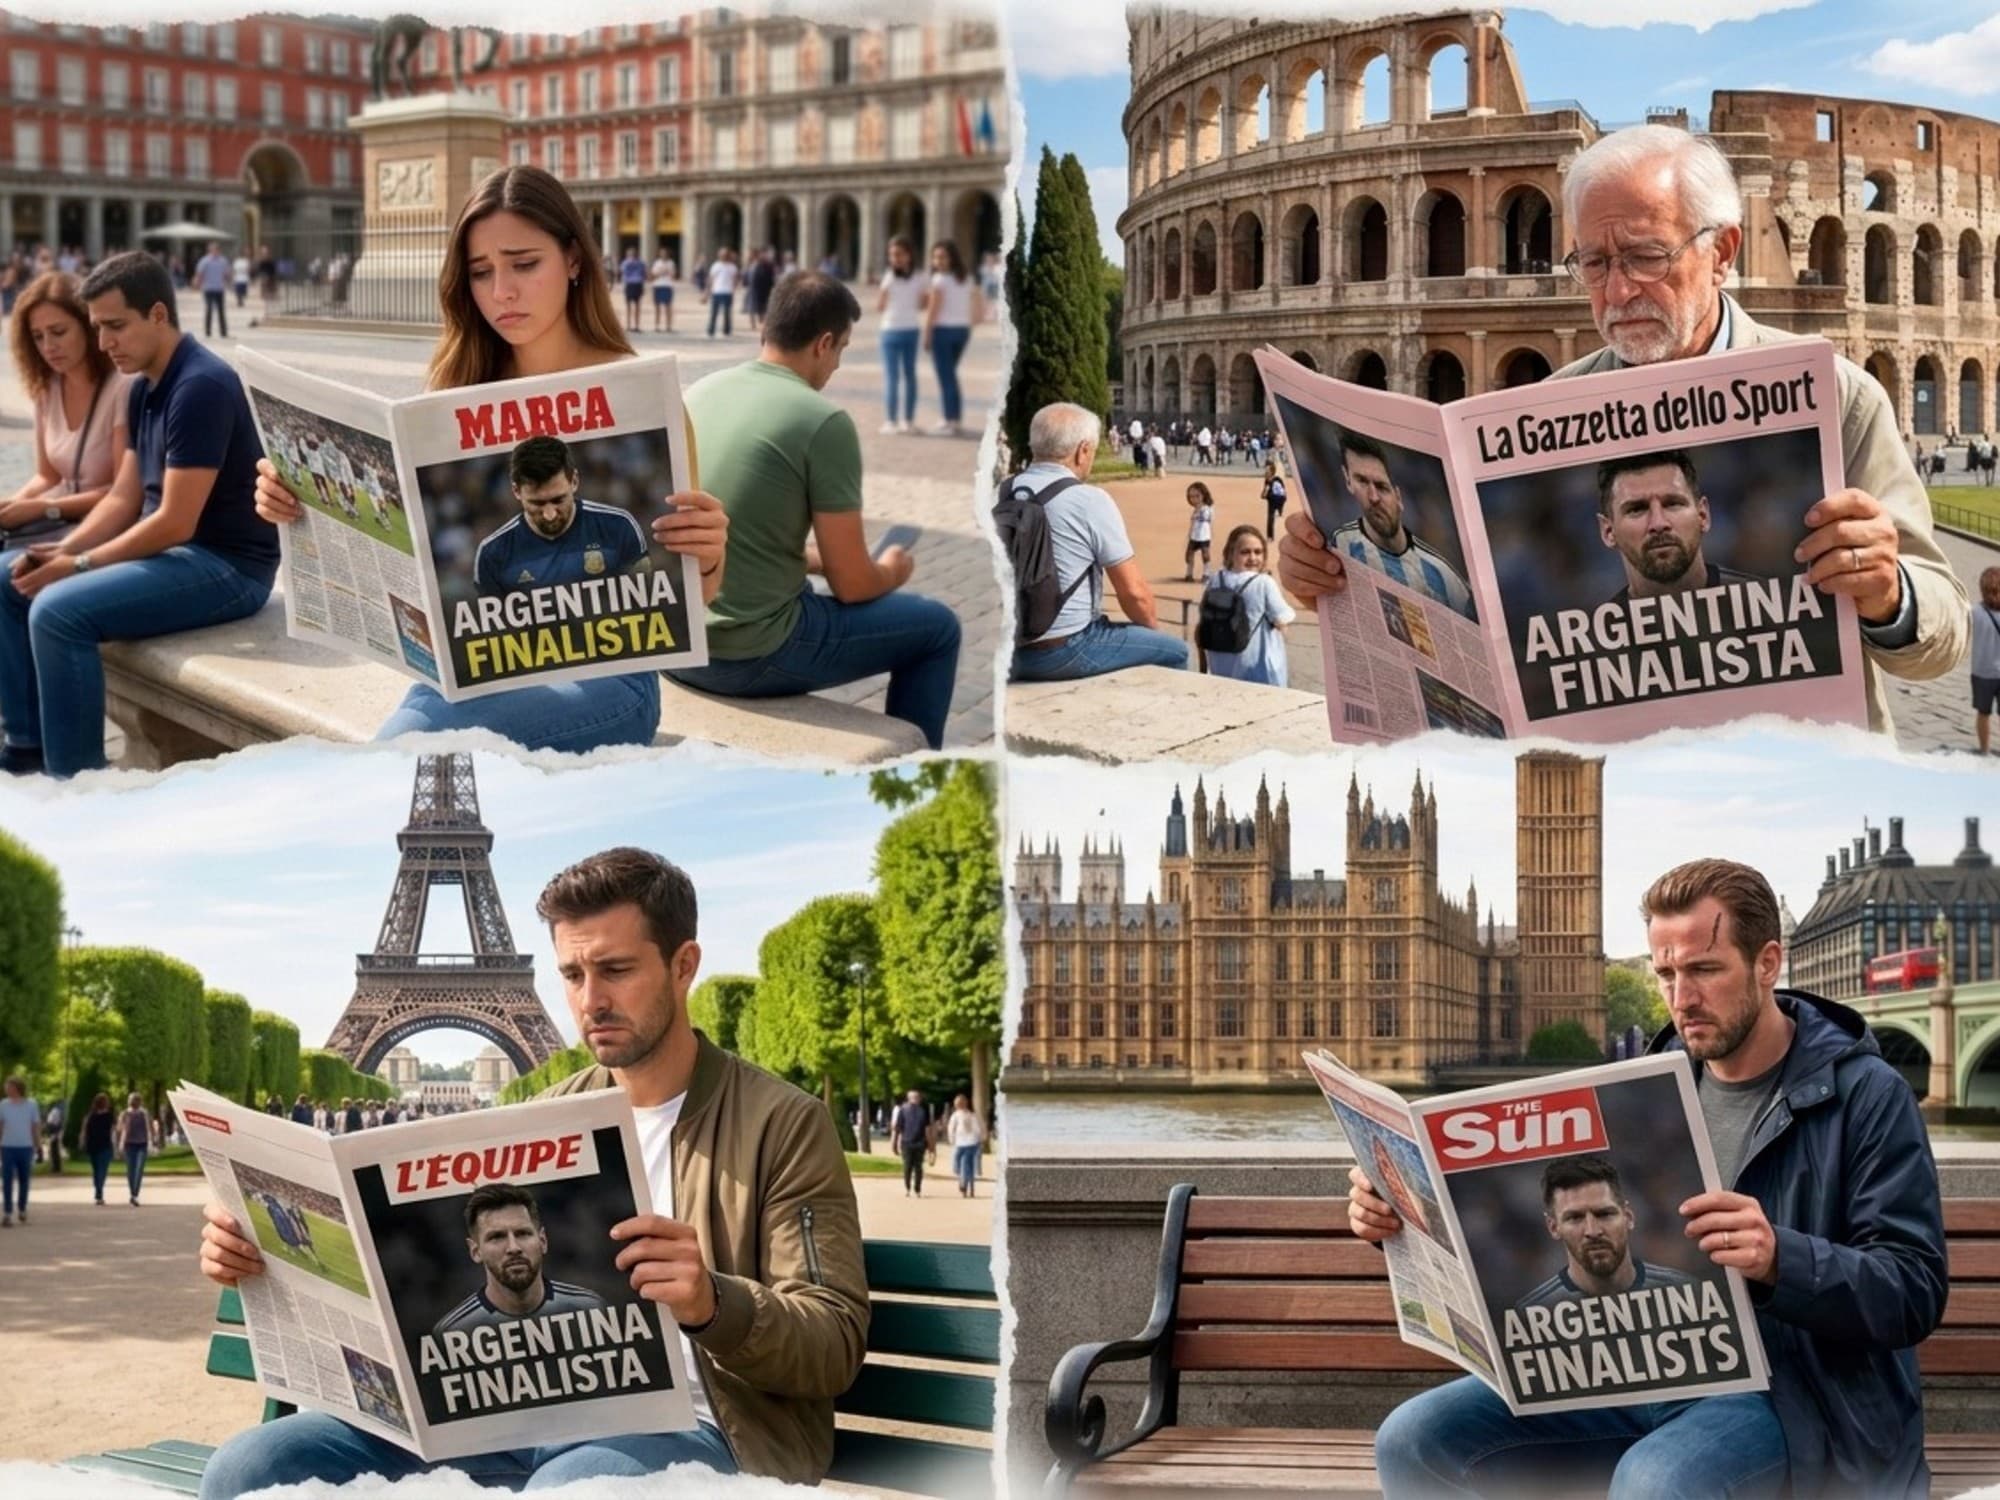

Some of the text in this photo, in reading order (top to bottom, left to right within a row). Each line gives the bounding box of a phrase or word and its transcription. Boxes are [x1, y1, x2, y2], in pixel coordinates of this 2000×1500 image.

[455, 386, 615, 450] MARCA
[1477, 371, 1817, 464] La Gazzetta dello Sport
[453, 569, 677, 638] ARGENTINA
[1526, 574, 1823, 662] ARGENTINA
[465, 613, 675, 678] FINALISTA
[1549, 629, 1815, 710] FINALISTA
[1441, 1106, 1593, 1160] Sun
[1502, 1100, 1543, 1118] THE
[419, 1302, 653, 1374] ARGENTINA
[1503, 1280, 1729, 1348] ARGENTINA
[440, 1349, 650, 1413] FINALISTA
[1510, 1324, 1739, 1395] FINALISTS
